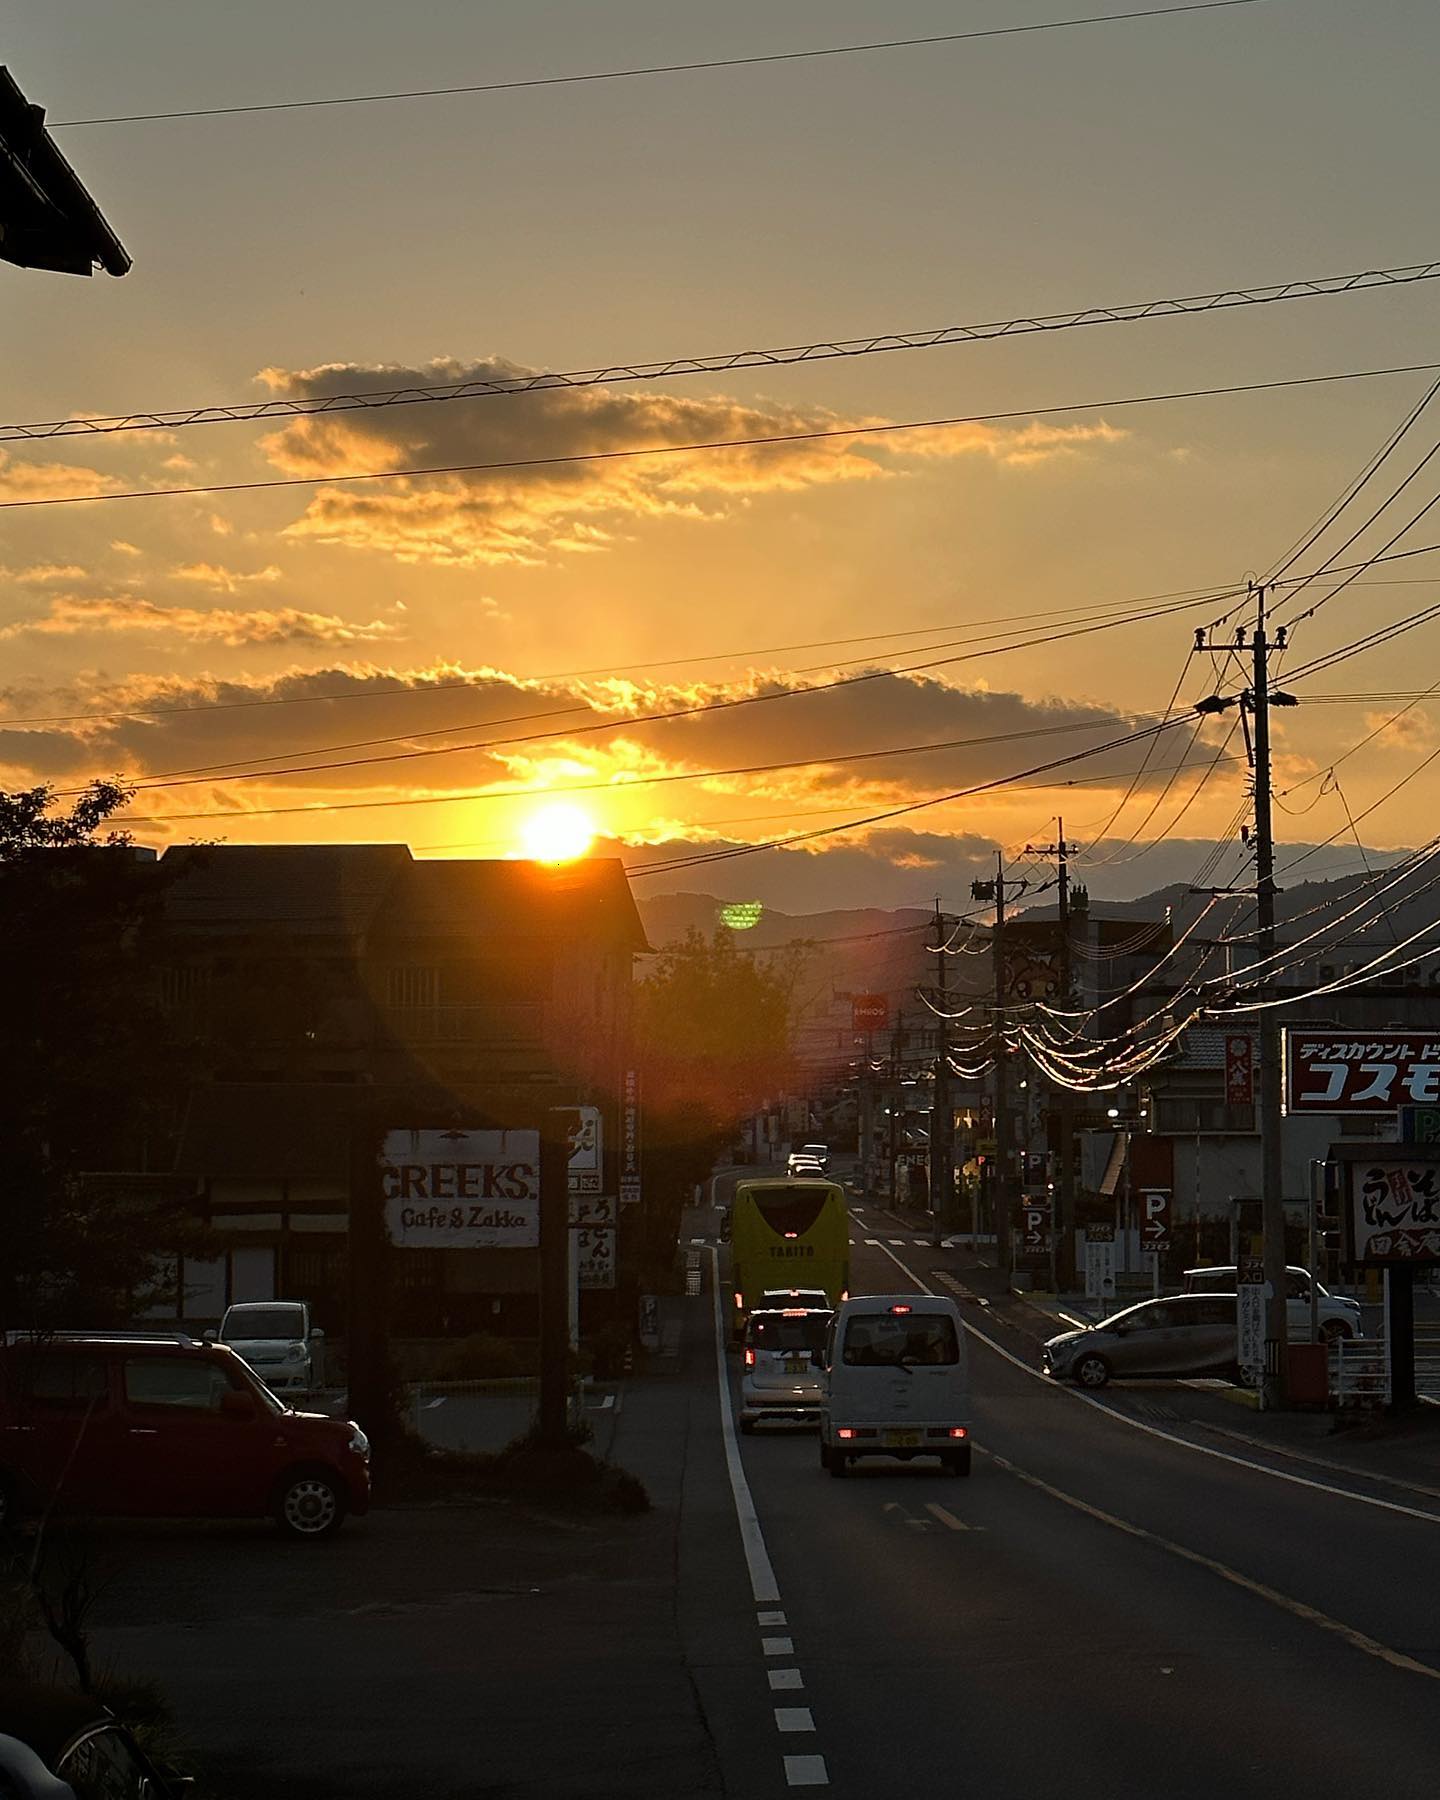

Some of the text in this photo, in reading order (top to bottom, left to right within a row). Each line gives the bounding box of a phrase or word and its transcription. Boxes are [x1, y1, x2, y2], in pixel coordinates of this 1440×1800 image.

[1299, 1042, 1416, 1060] ディスカウント
[1146, 1194, 1166, 1220] P
[401, 1207, 446, 1232] Cafe
[466, 1206, 528, 1228] Zakka
[1027, 1212, 1042, 1231] P
